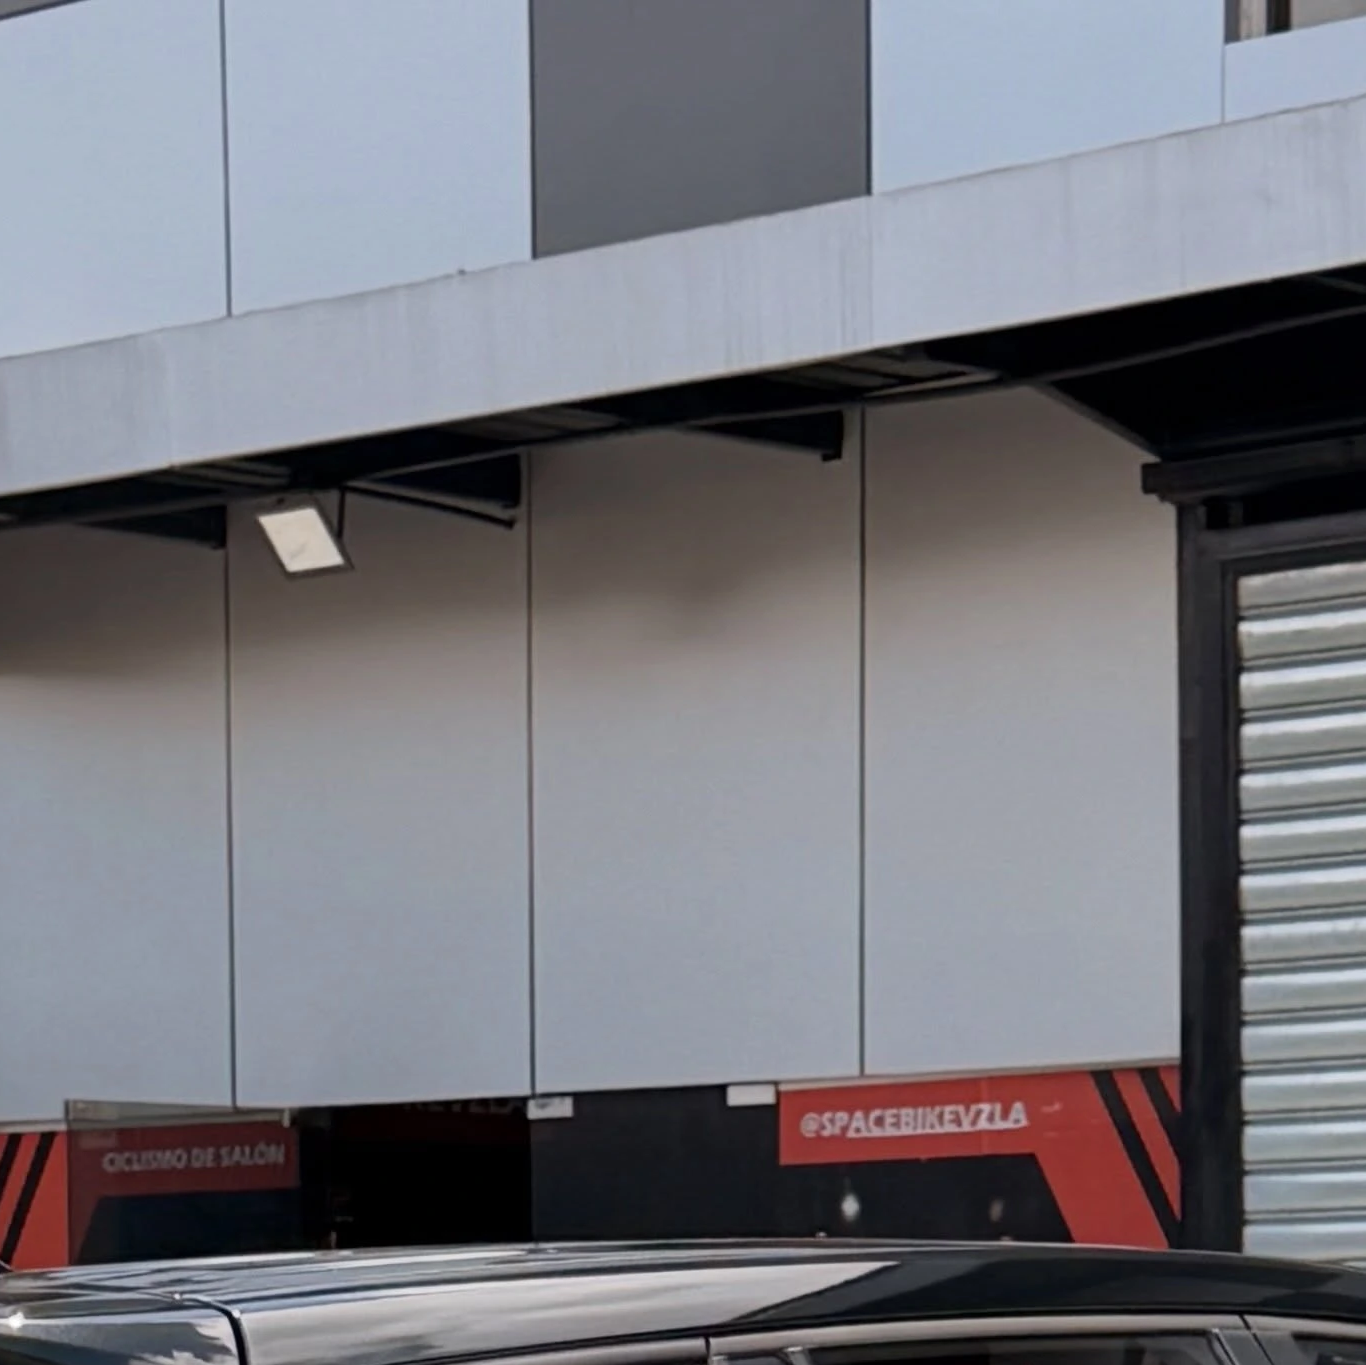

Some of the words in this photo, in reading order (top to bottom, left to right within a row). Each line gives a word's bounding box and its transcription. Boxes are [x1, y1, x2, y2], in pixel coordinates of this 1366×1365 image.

[800, 1101, 1029, 1139] @SPACEBIKEVZLA
[102, 1147, 187, 1173] CICLISMO
[190, 1146, 217, 1168] DE
[219, 1141, 285, 1168] SALÓN
